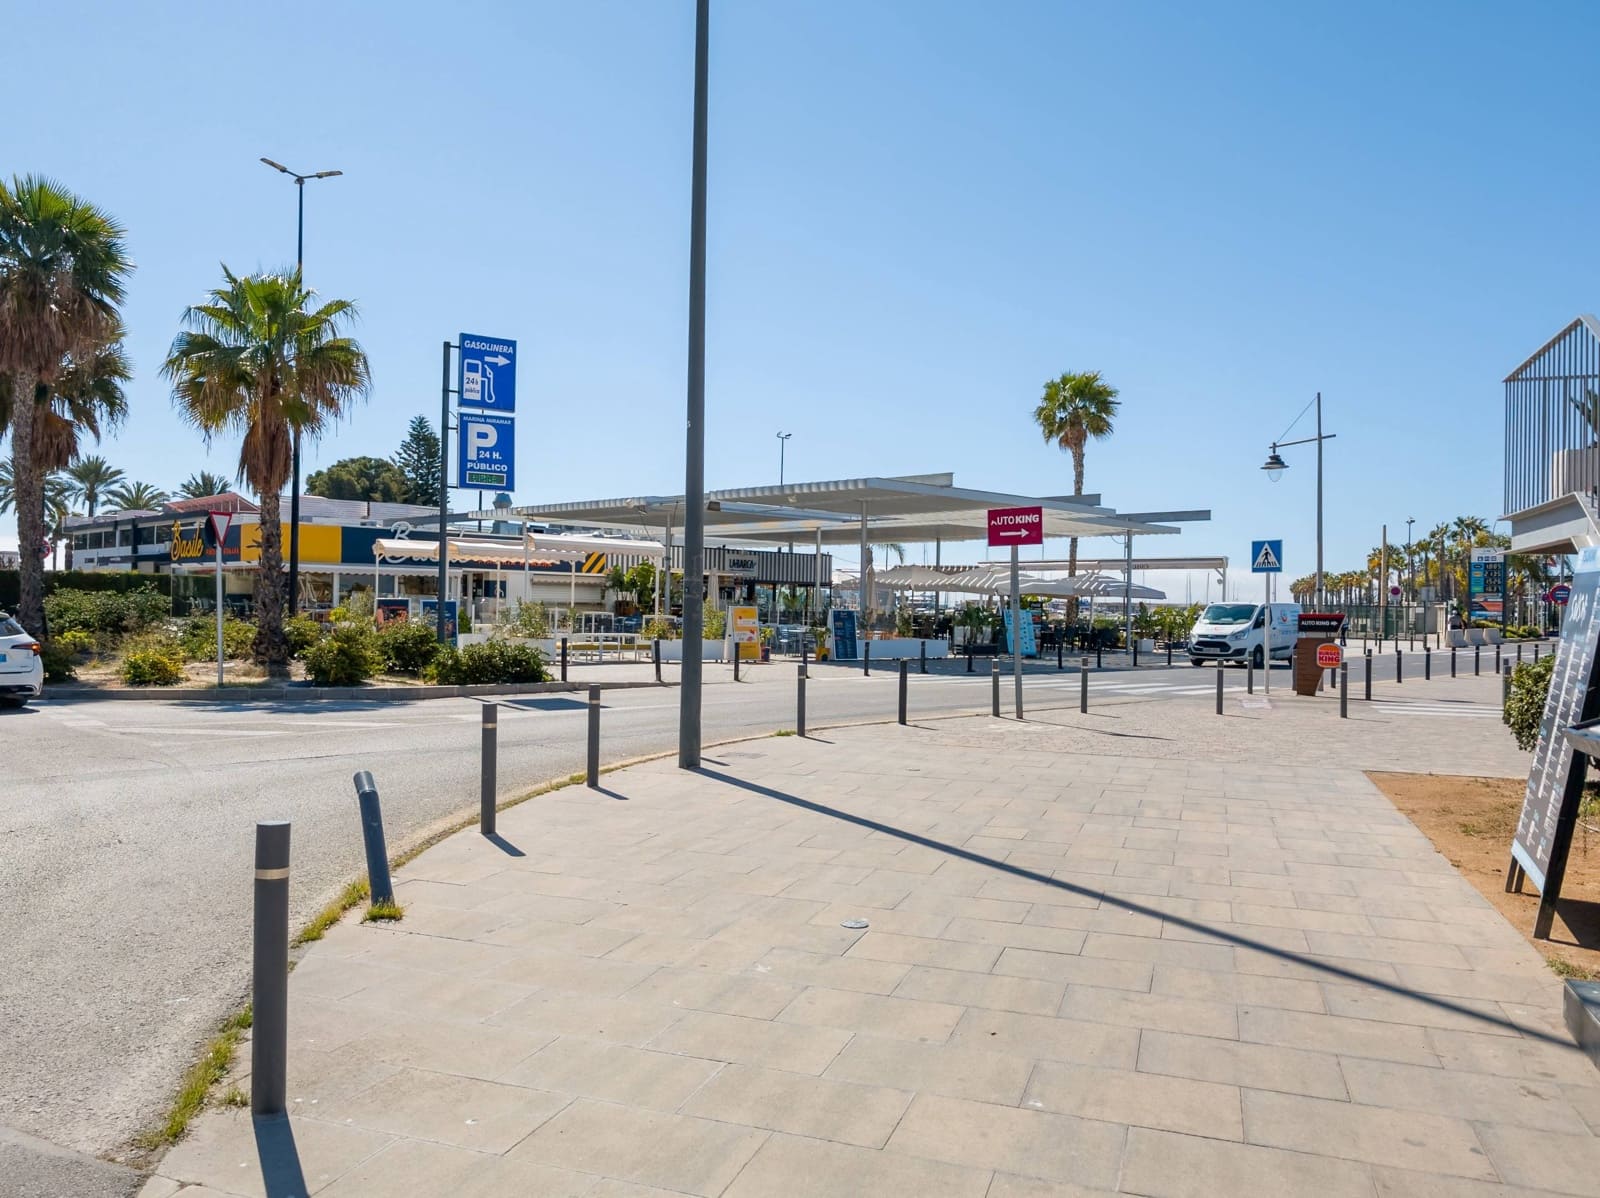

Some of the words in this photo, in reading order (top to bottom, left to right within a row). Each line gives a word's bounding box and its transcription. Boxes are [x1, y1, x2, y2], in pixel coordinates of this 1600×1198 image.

[464, 340, 514, 354] GASOLINERA
[465, 376, 475, 385] 24
[467, 422, 498, 461] P
[479, 450, 490, 459] 24
[492, 451, 503, 460] H.
[467, 460, 508, 472] PÚBLICO
[1015, 513, 1040, 525] KING
[1319, 655, 1341, 663] KING
